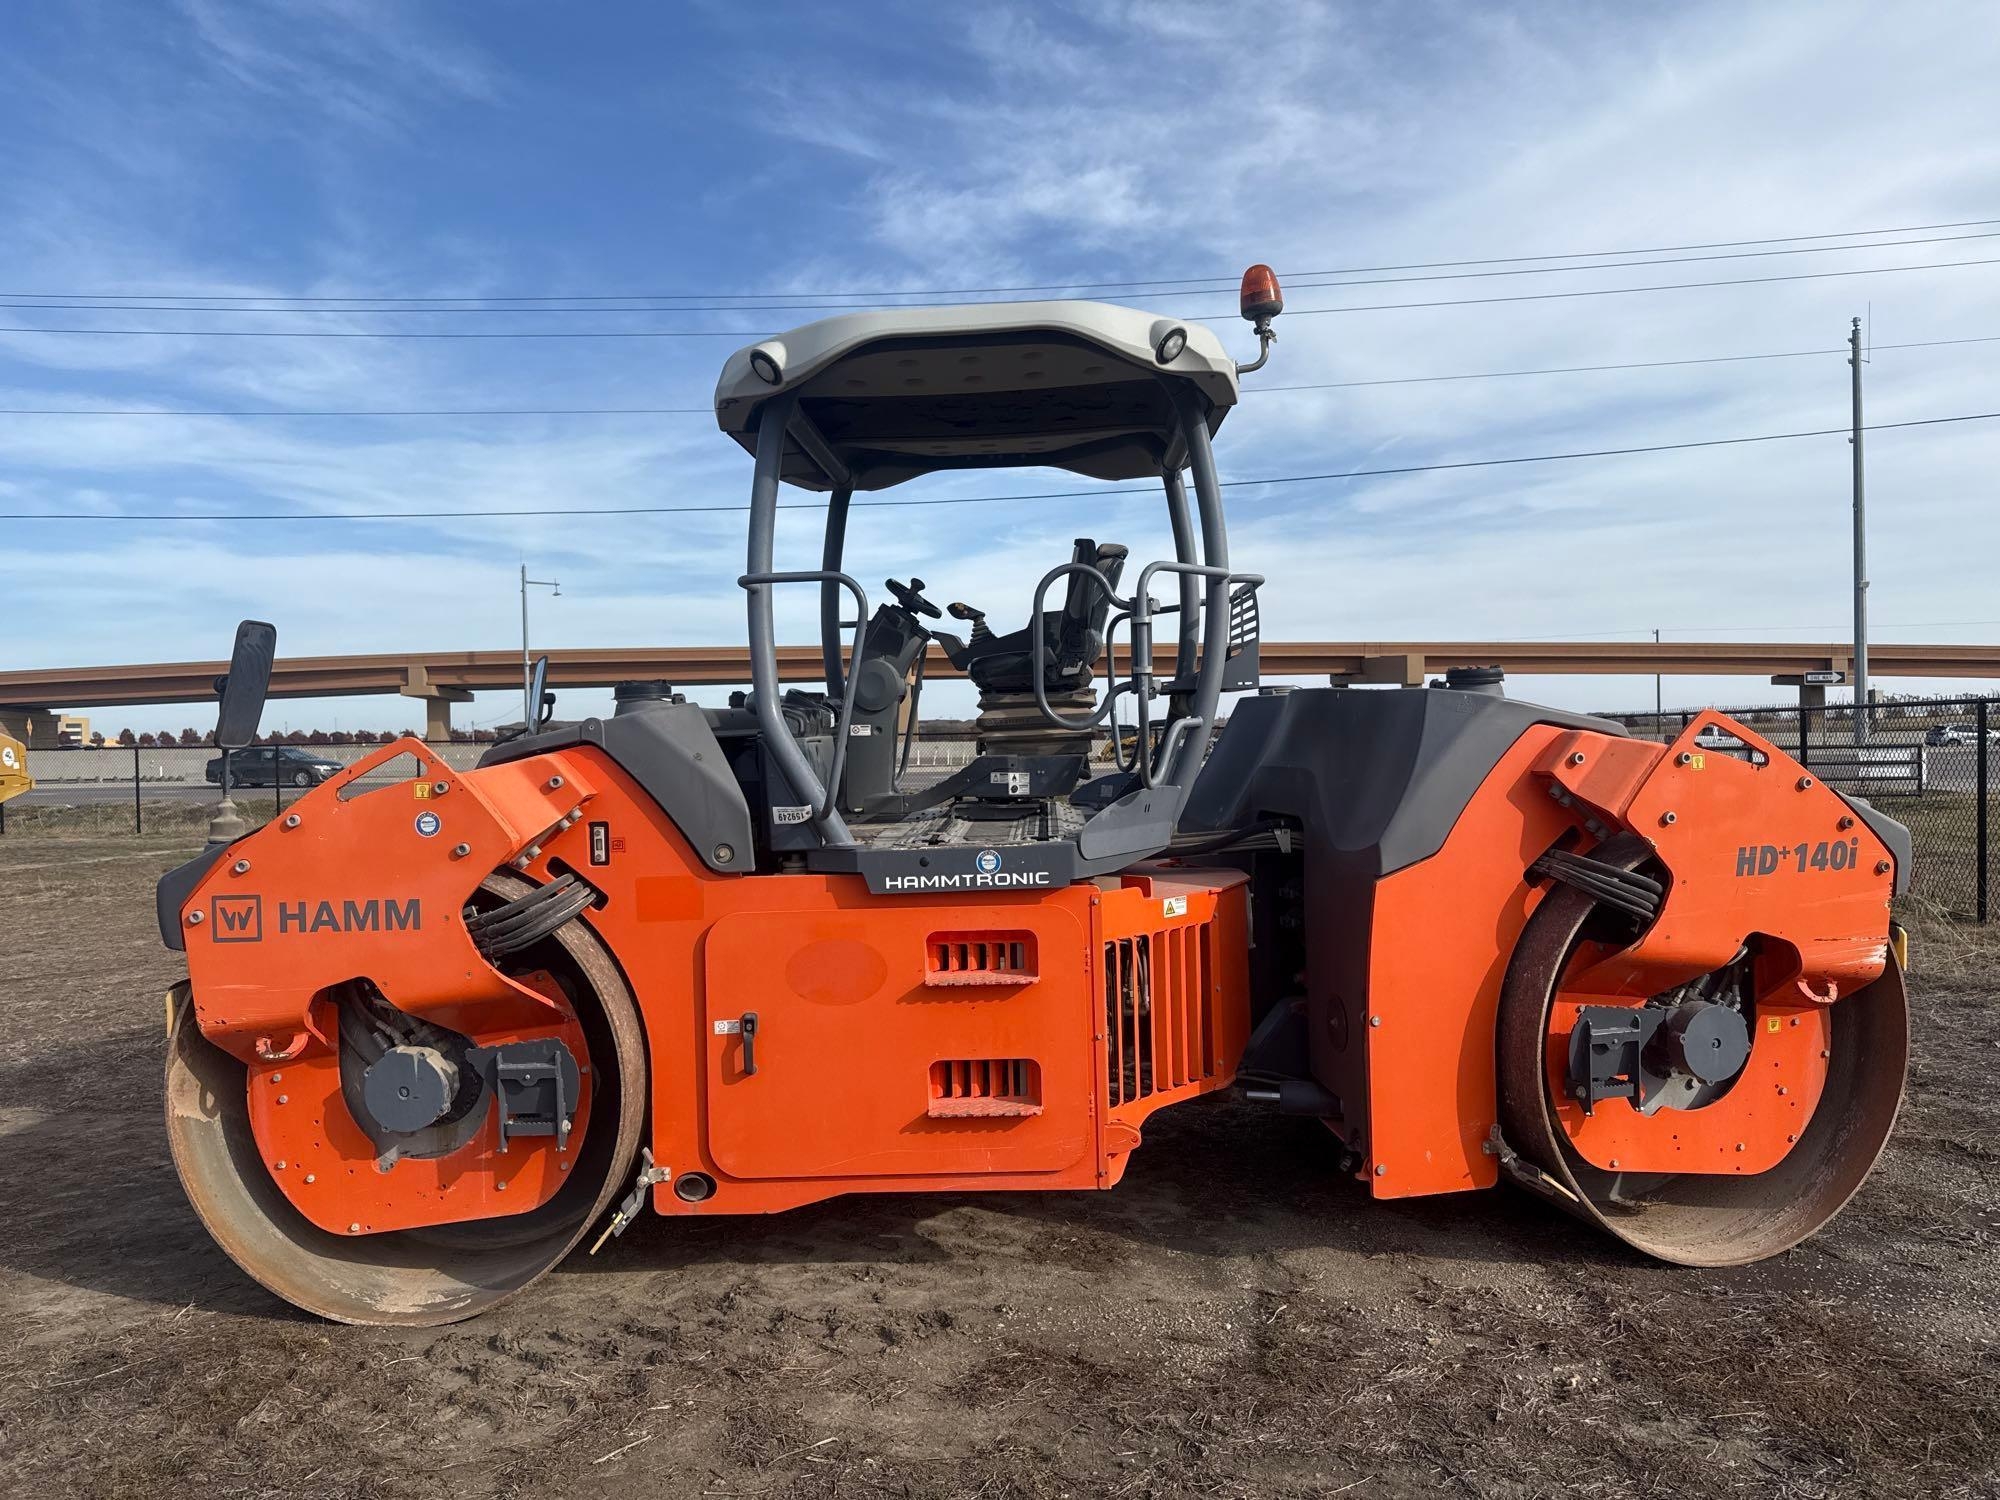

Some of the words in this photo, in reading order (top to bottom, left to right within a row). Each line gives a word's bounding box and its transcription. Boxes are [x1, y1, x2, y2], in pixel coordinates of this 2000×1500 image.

[778, 812, 805, 821] 159249
[1794, 837, 1858, 872] 140i
[885, 872, 1050, 889] HAMMTRONIC
[279, 899, 421, 933] HAMM
